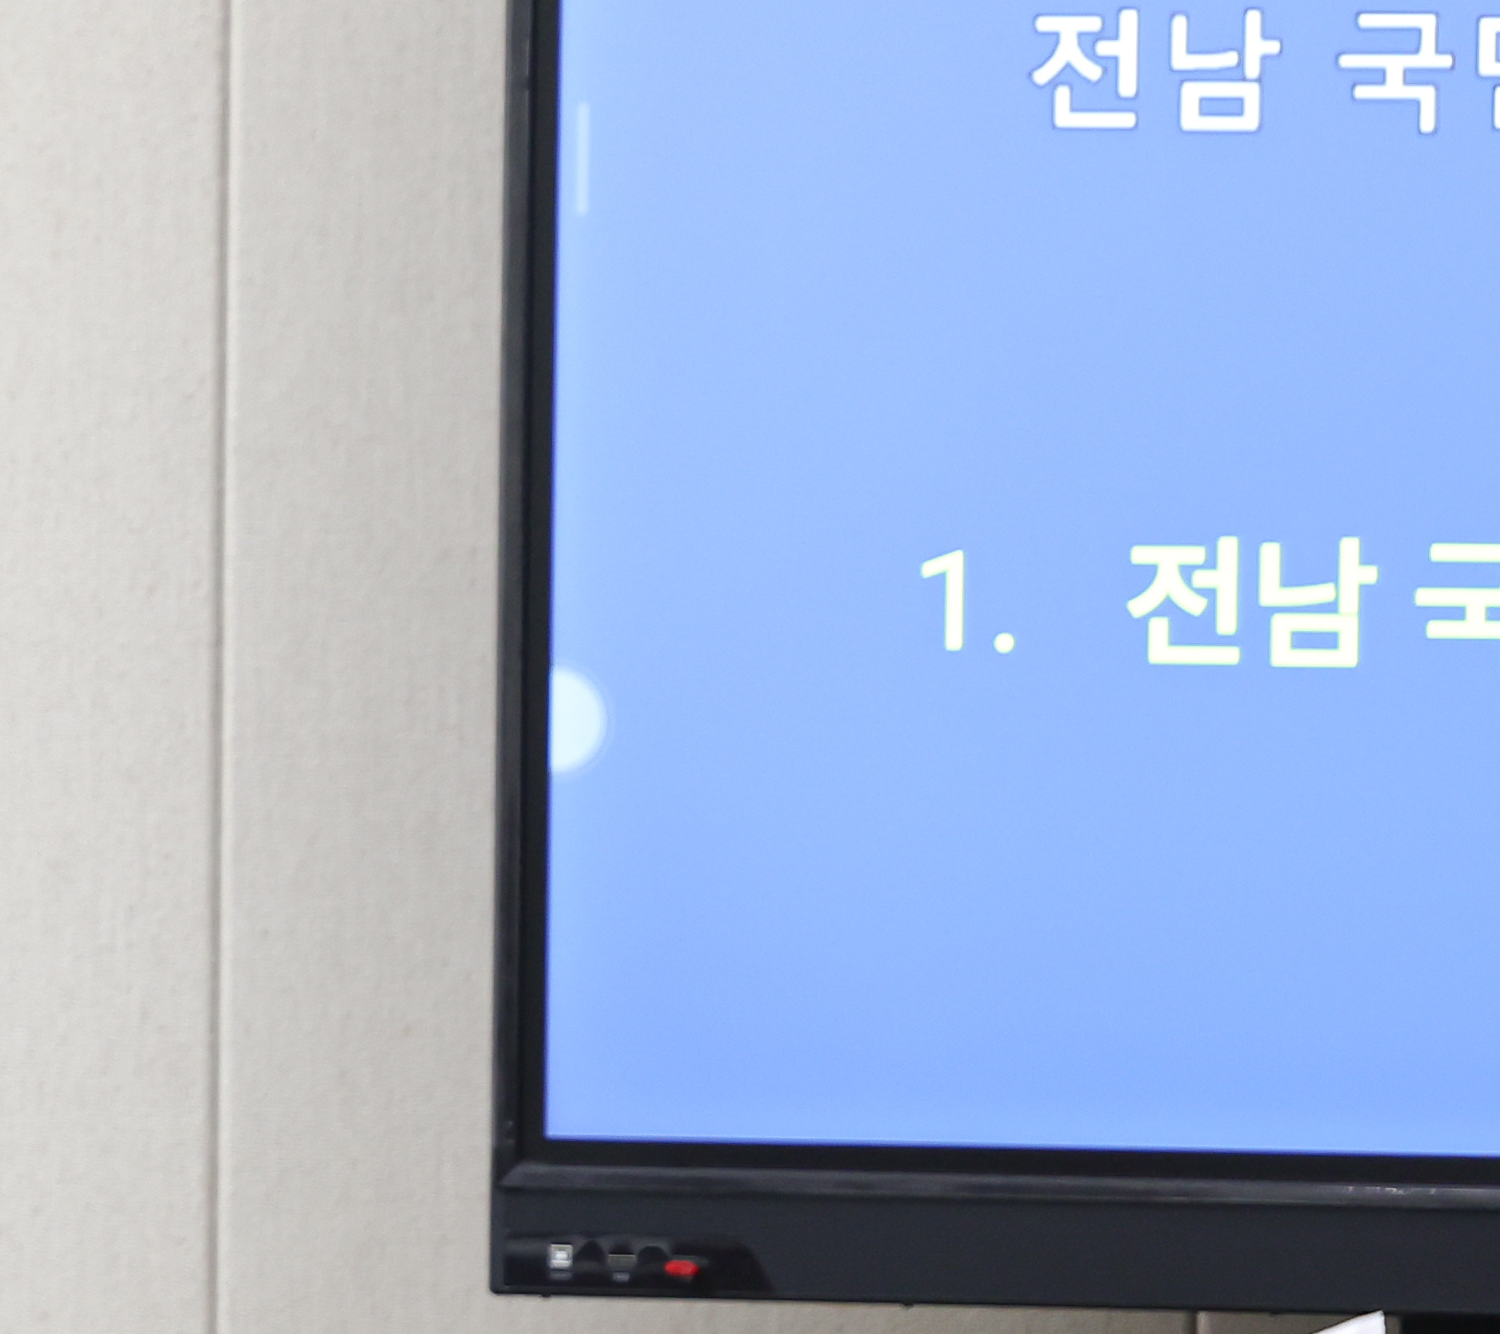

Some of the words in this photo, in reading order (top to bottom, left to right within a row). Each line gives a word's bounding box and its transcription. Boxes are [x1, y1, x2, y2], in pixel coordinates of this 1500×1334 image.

[1031, 7, 1282, 133] 전남
[1337, 11, 1500, 135] 국
[920, 549, 1016, 654] 1.
[1126, 535, 1379, 669] 전남
